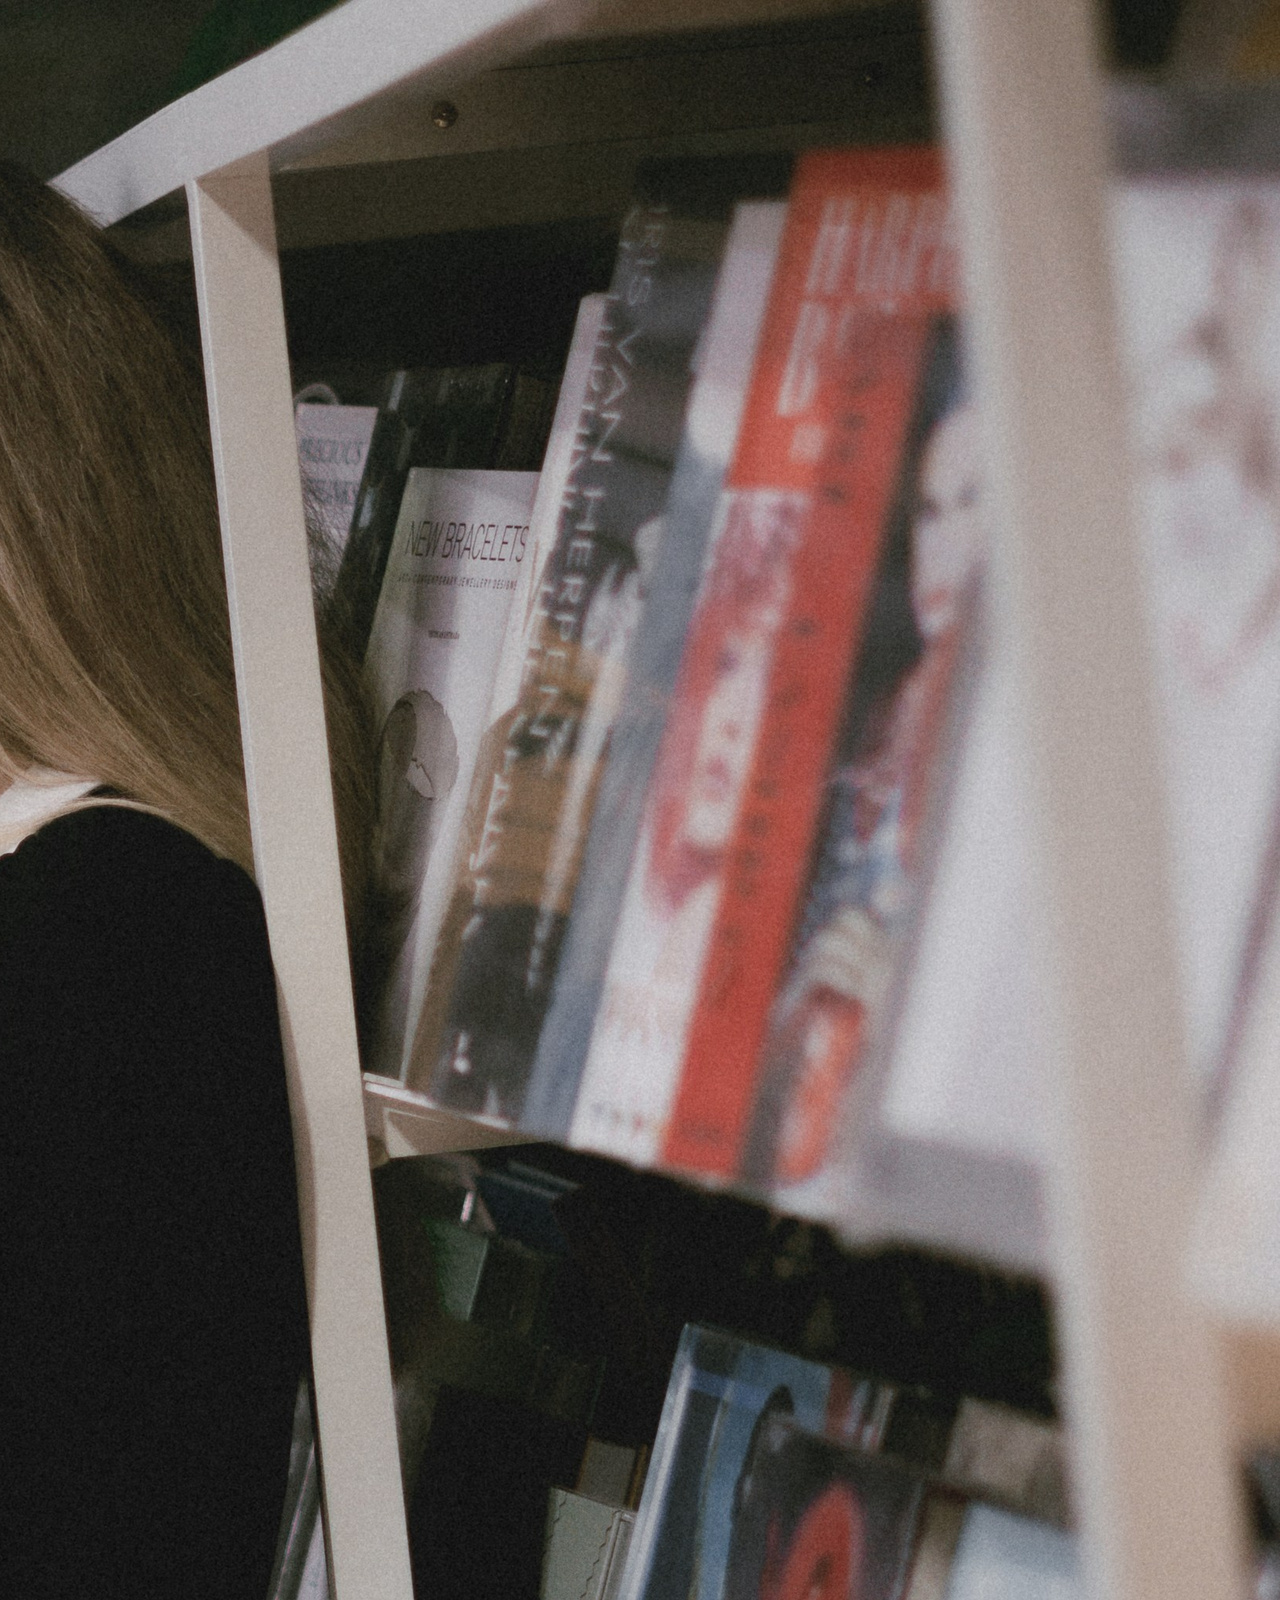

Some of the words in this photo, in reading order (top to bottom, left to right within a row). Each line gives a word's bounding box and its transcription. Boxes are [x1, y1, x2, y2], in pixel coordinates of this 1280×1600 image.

[591, 326, 642, 462] VAN
[404, 520, 445, 558] NEW
[441, 522, 530, 563] BRACELETS
[529, 488, 606, 736] HERPEN
